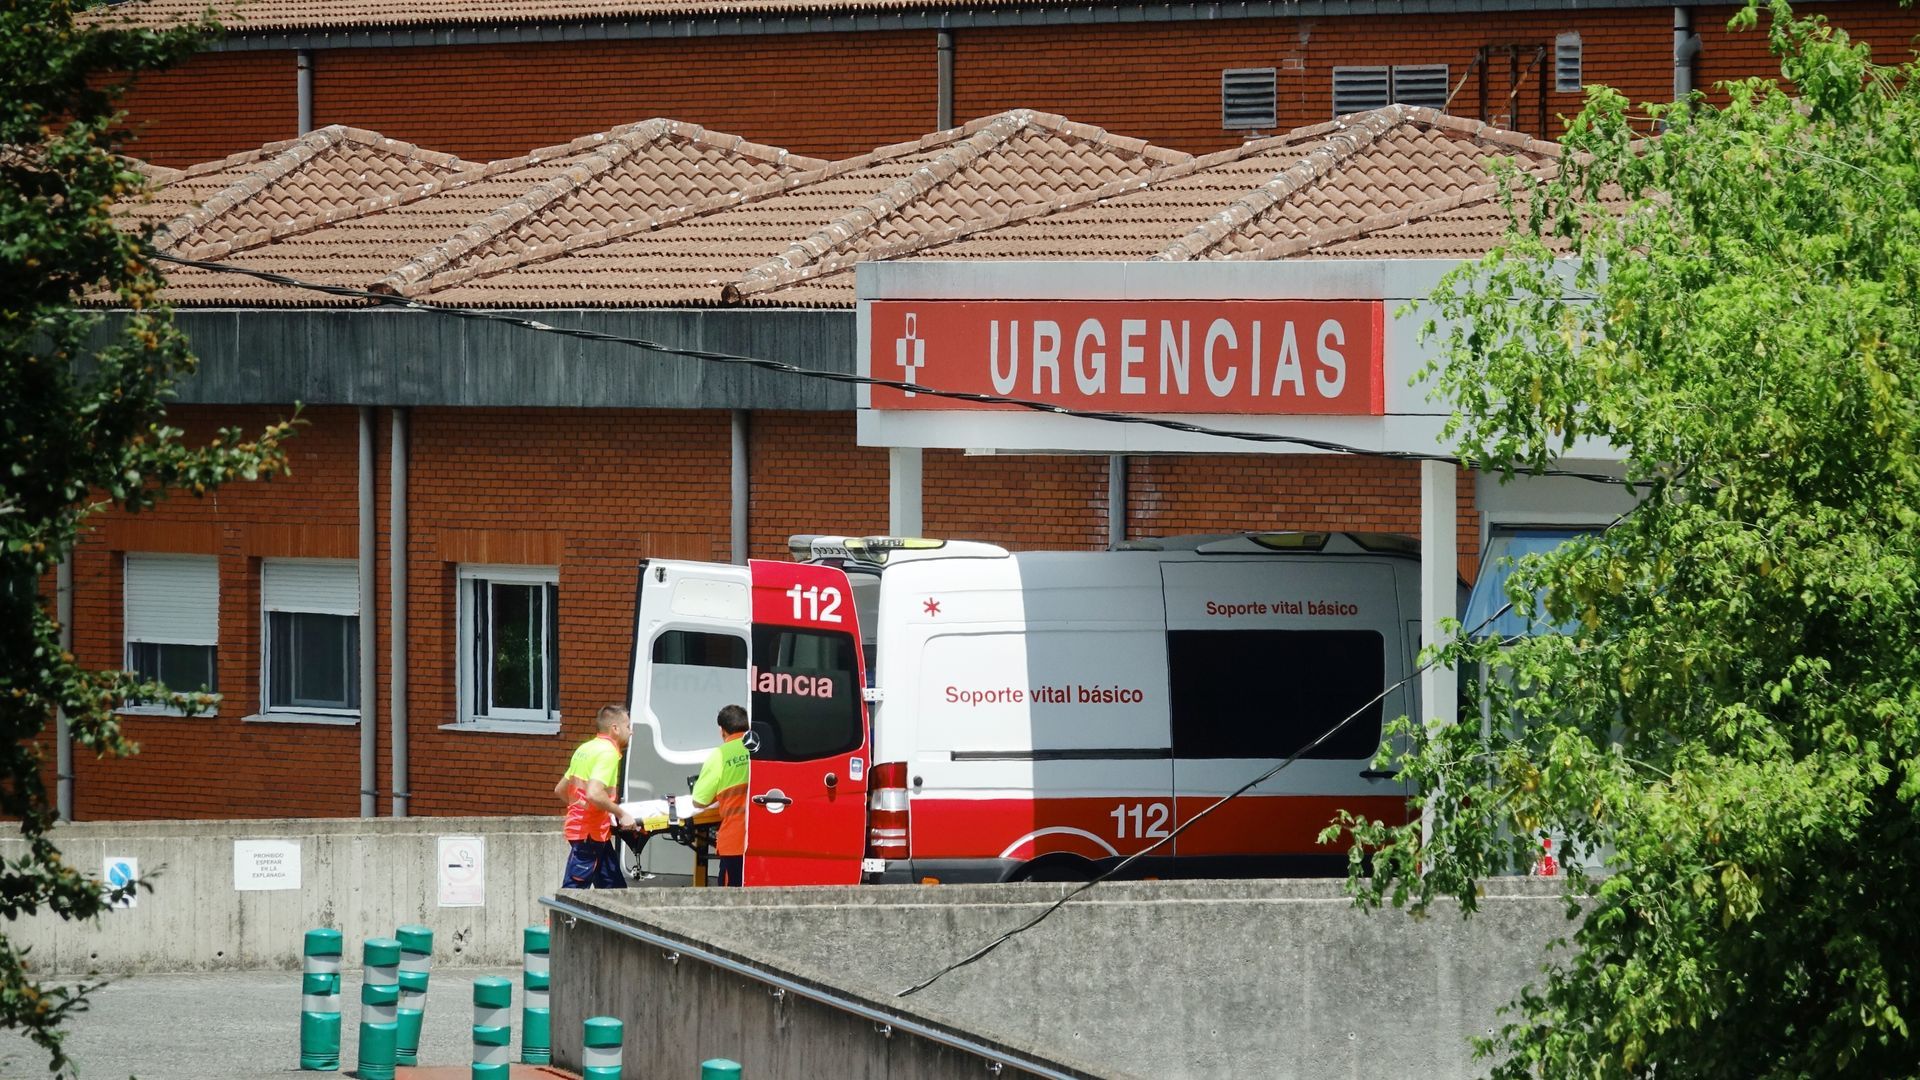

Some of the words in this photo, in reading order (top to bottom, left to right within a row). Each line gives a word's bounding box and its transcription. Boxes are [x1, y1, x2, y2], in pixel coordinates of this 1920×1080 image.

[989, 317, 1347, 399] URGENCIAS
[786, 583, 842, 623] 112
[1206, 601, 1267, 618] Soporte
[1271, 601, 1303, 615] vital
[1307, 600, 1358, 615] básico
[945, 685, 1024, 707] Soporte
[1030, 685, 1071, 704] vital
[1078, 685, 1144, 704] básico
[1110, 802, 1170, 839] 112
